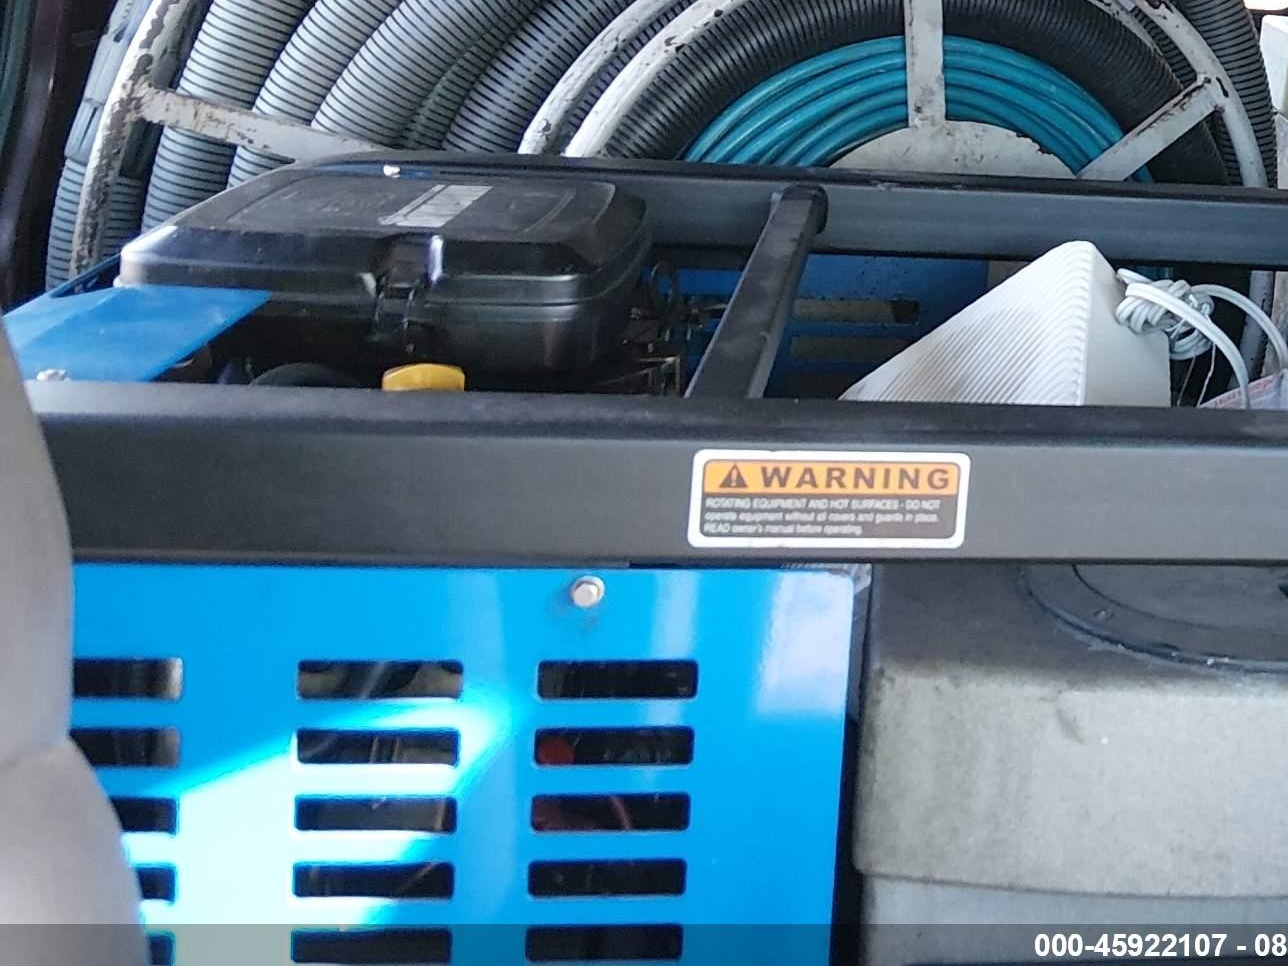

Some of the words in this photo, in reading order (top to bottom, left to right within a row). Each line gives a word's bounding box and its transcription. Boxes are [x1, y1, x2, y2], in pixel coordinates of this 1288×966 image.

[761, 466, 949, 490] WARNING
[705, 497, 751, 508] ROTATING
[752, 498, 807, 509] EQUIPMENT
[808, 499, 829, 509] AND
[850, 499, 899, 509] SURFACES
[905, 500, 920, 510] DO
[921, 500, 941, 510] NOT
[739, 512, 783, 523] equipment
